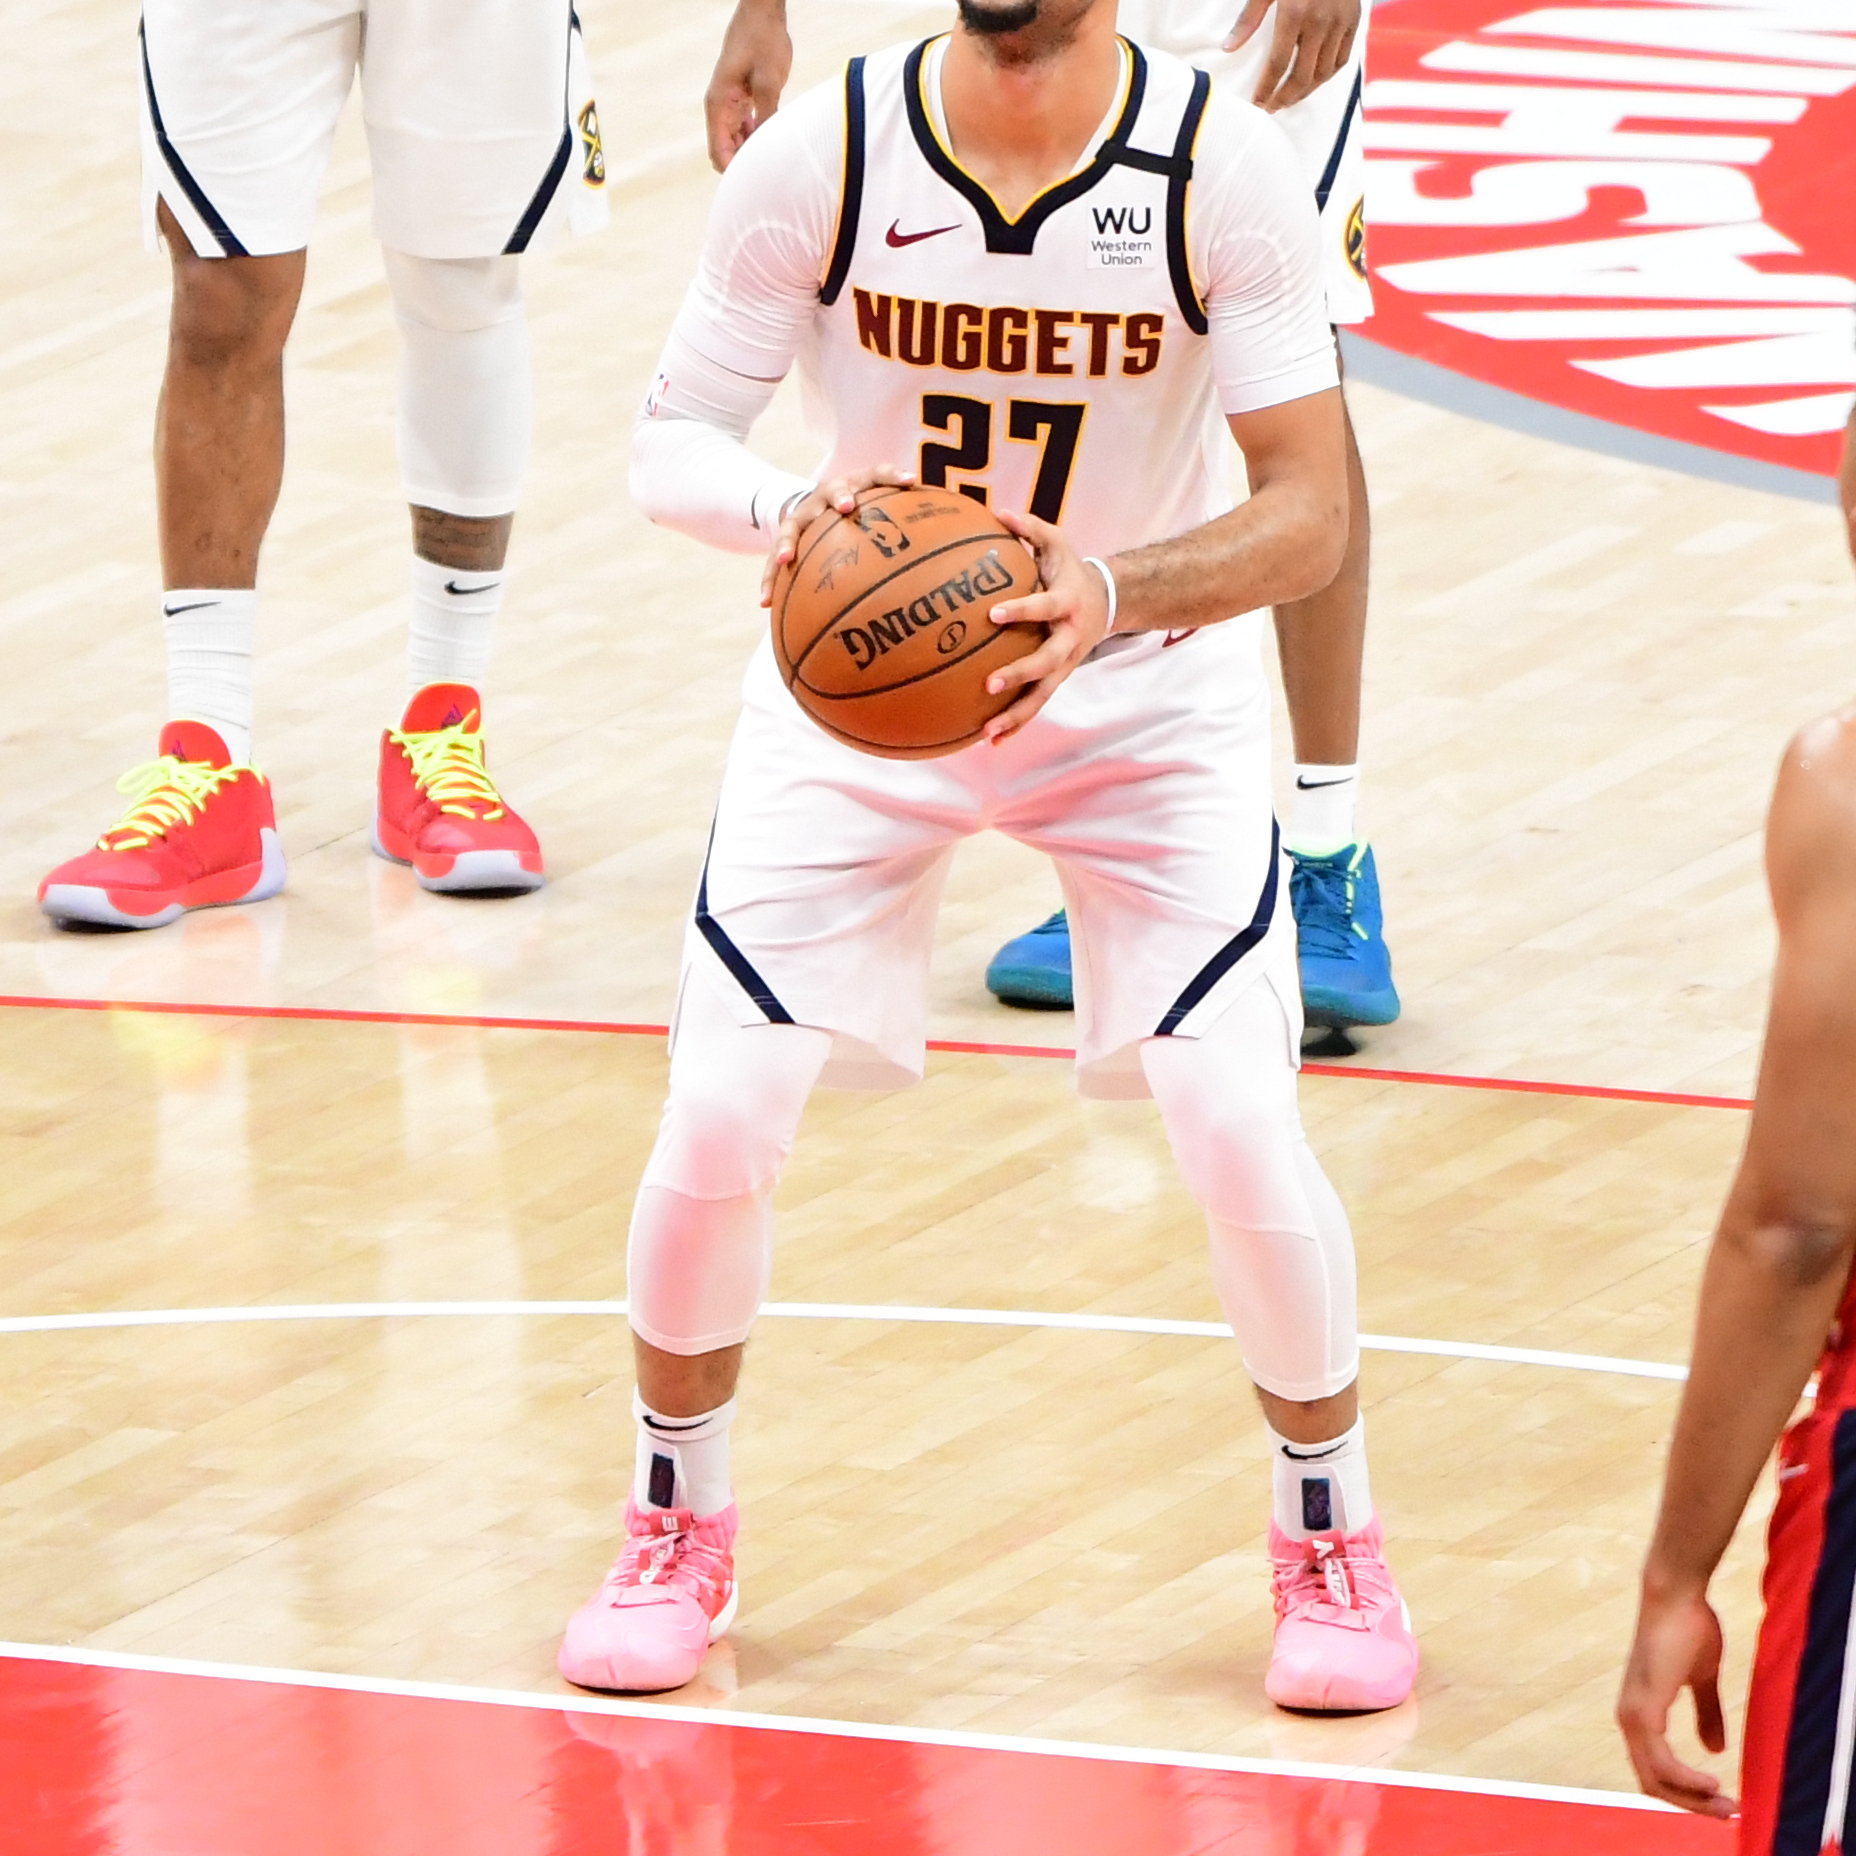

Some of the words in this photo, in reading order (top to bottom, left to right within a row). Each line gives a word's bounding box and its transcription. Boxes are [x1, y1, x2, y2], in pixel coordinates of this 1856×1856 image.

[1091, 240, 1152, 252] Western
[1092, 207, 1151, 235] WU
[1101, 252, 1143, 266] Union
[852, 286, 1164, 380] NUGGETS
[919, 391, 1089, 528] 27
[838, 548, 1014, 671] SPALDING
